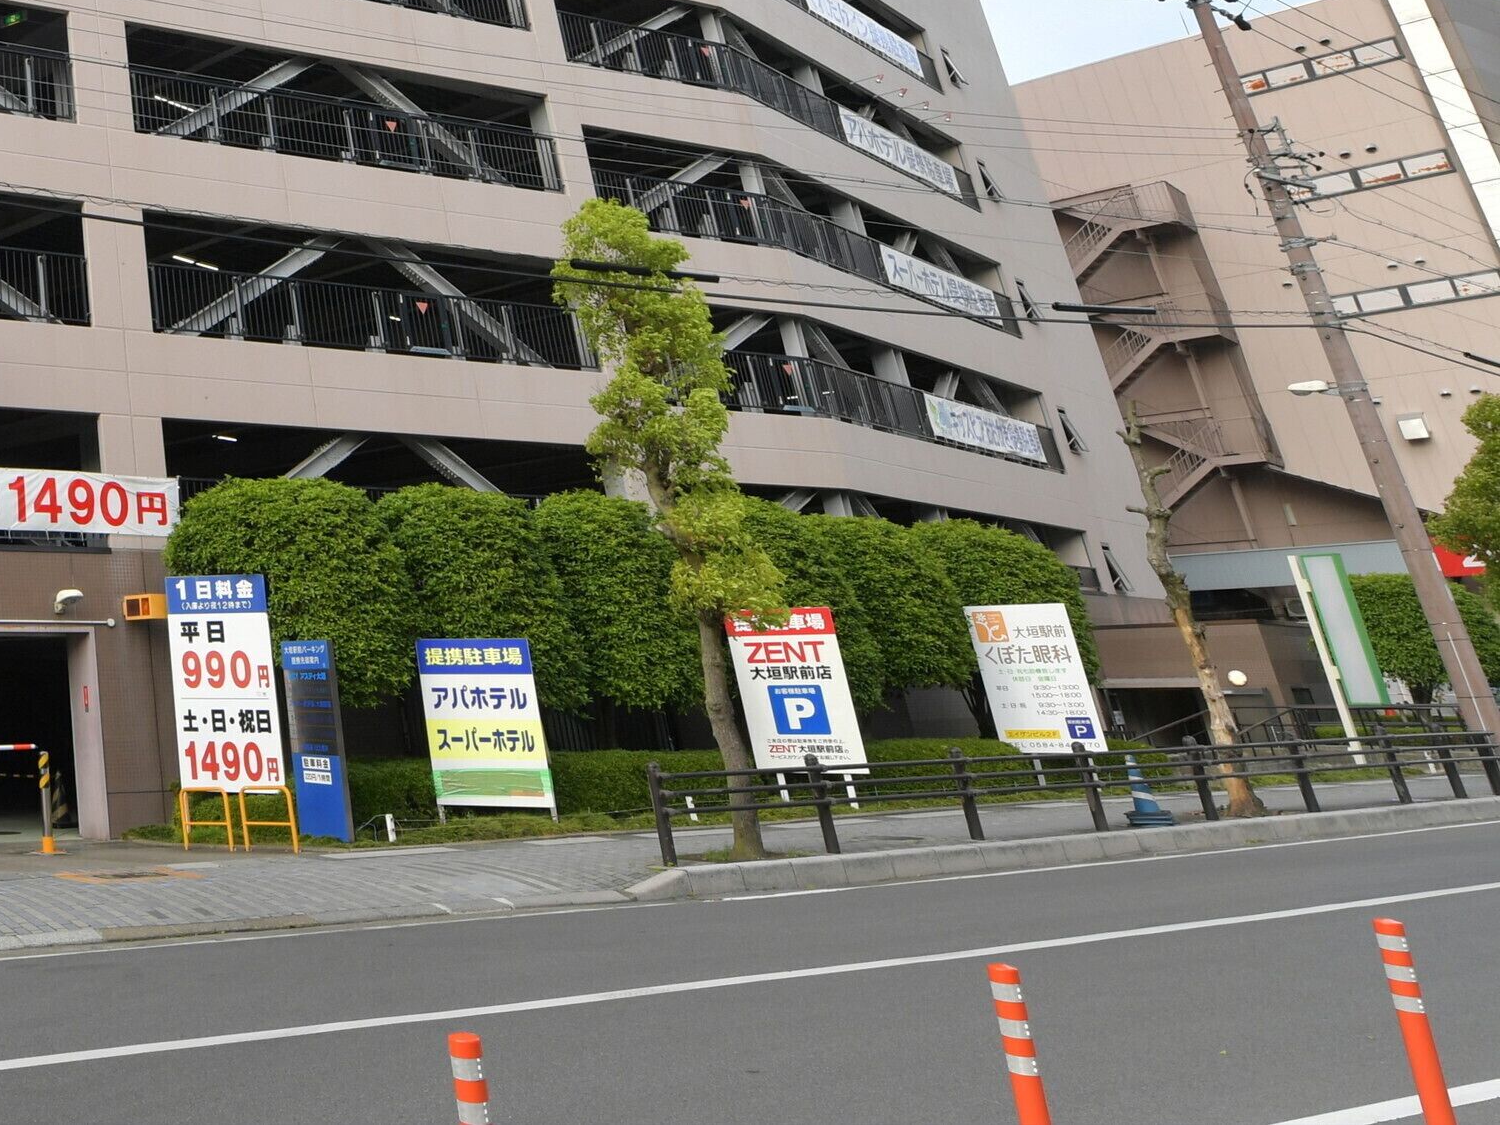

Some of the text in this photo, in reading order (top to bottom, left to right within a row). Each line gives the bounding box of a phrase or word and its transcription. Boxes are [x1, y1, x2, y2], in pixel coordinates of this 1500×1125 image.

[8, 476, 168, 527] 1490円
[175, 580, 253, 600] 1日料金
[180, 621, 225, 643] 平日
[1013, 625, 1067, 638] 大垣駅前
[425, 647, 522, 666] 提携駐車場
[744, 641, 825, 664] ZENT
[984, 644, 1072, 665] くぼた眼科
[182, 650, 270, 689] 990円
[750, 665, 832, 681] 大垣駅前店
[431, 685, 527, 710] アパホテル
[183, 709, 271, 734] 土・日・祝日
[784, 698, 815, 730] P
[437, 727, 535, 753] スーパーホテル
[1074, 726, 1087, 737] P
[769, 744, 797, 753] ZENT
[185, 741, 279, 782] 1490円
